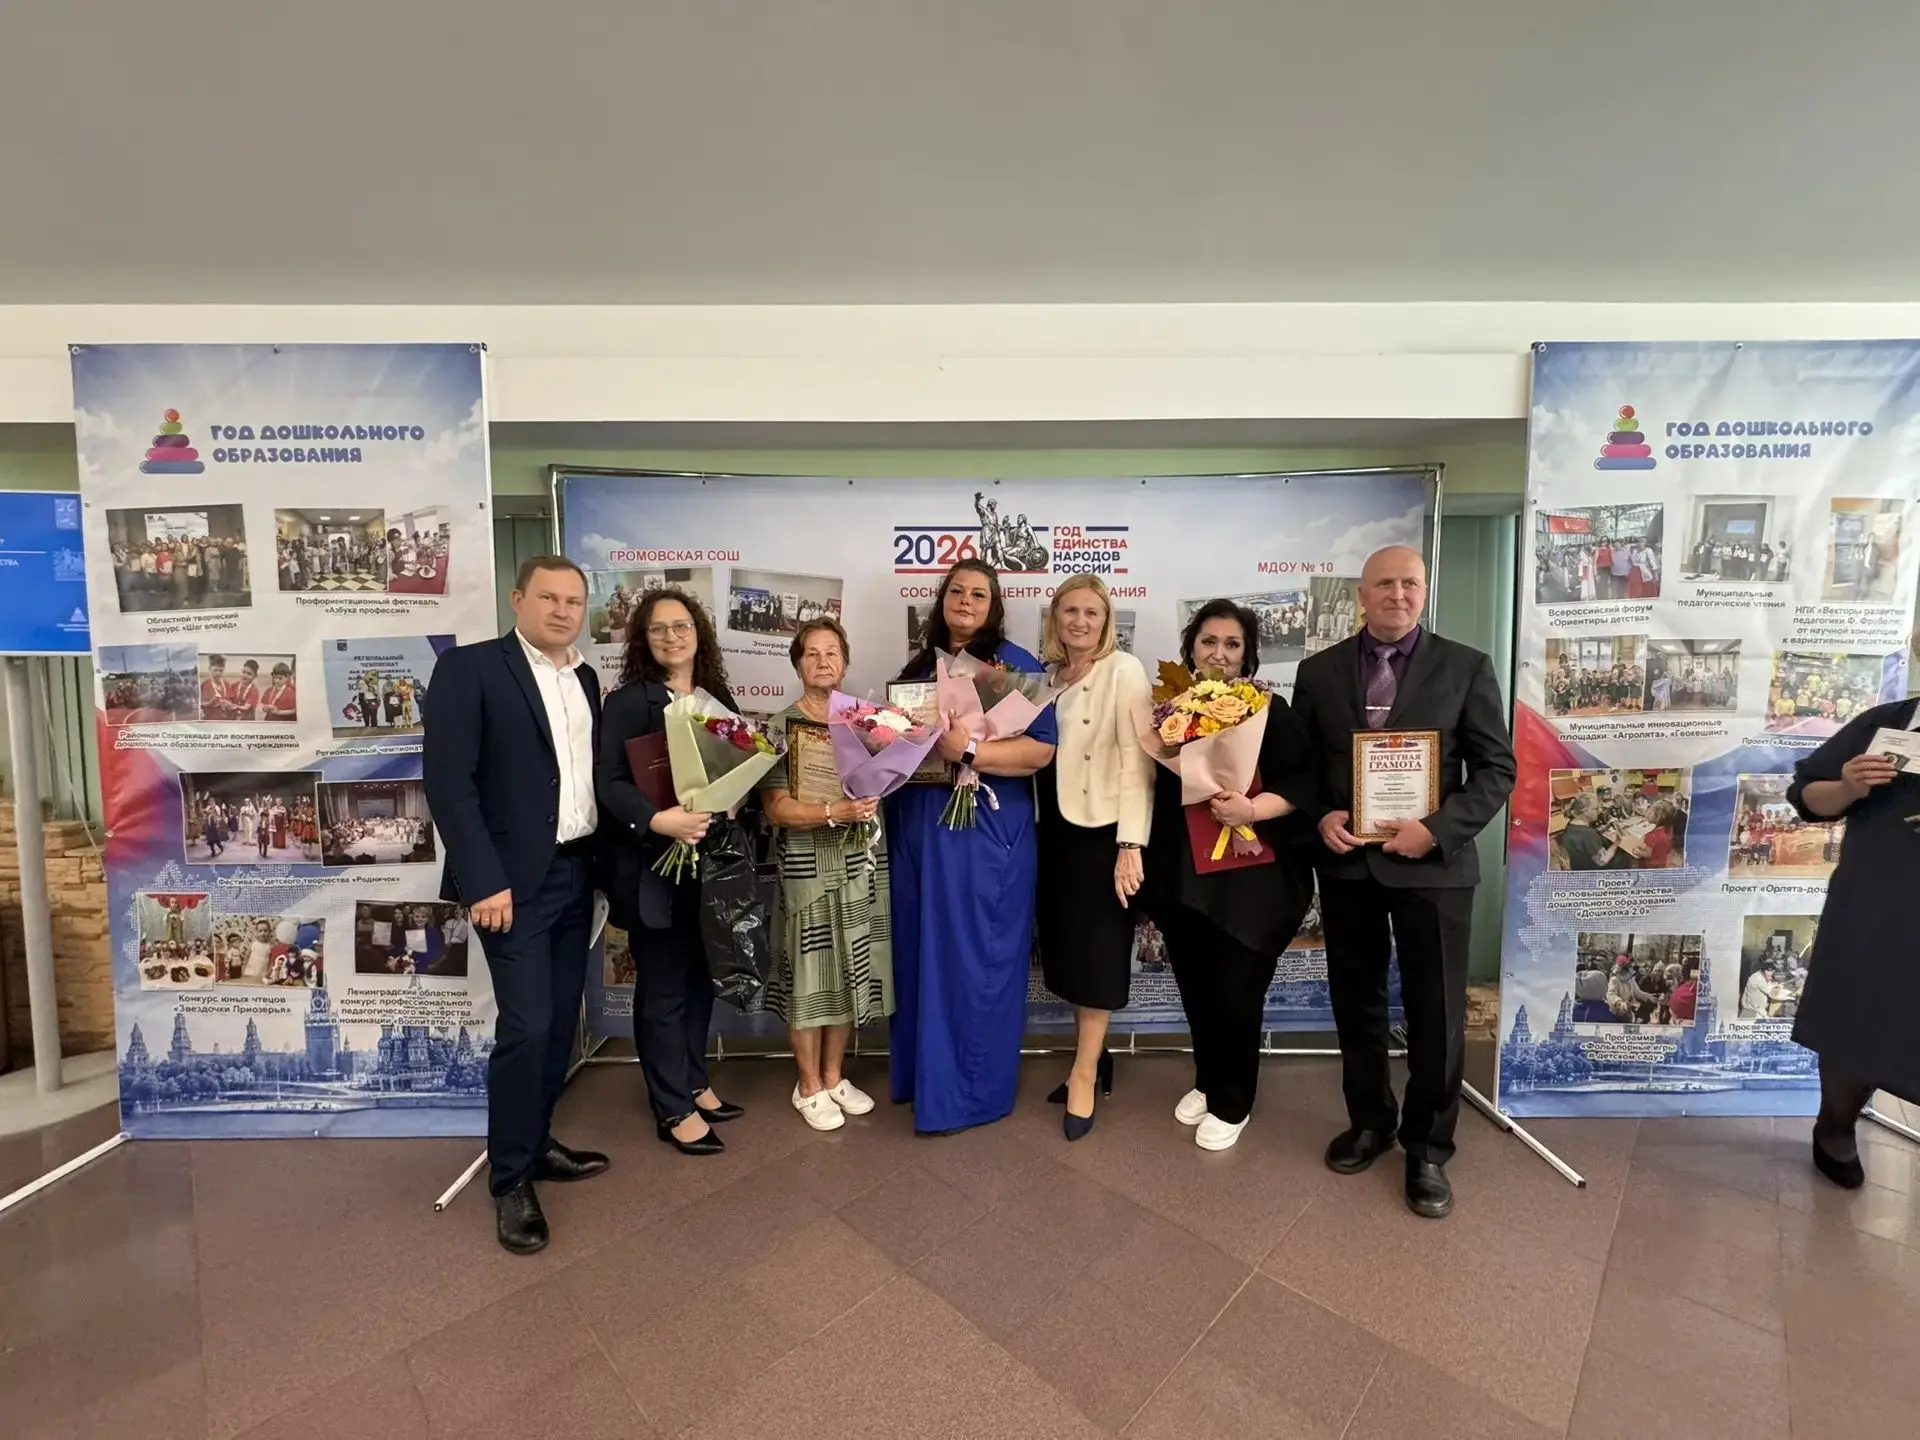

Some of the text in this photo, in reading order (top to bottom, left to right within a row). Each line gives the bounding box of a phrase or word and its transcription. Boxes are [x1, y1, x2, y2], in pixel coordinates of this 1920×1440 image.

[210, 425, 425, 440] ГОД ДОШКОЛЬНОГО
[1666, 421, 1874, 437] ГОД ДОШКОЛЬНОГО
[212, 447, 362, 463] ОБРАЗОВАНИЯ
[1665, 443, 1811, 459] ОБРАЗОВАНИЯ
[1053, 526, 1081, 538] ГОД
[893, 534, 977, 565] 2026
[1053, 539, 1128, 550] ЕДИНСТВА
[610, 550, 740, 561] ГРОМОВСКАЯ СОШ
[1053, 551, 1121, 563] НАРОДОВ
[1053, 564, 1112, 574] РОССИИ
[1257, 562, 1333, 574] МДОУ № 10
[900, 587, 938, 598] СОСН
[1696, 589, 1773, 598] Муниципальные
[296, 597, 439, 606] Профориентационный фестиваль
[1678, 599, 1751, 607] педагогические
[325, 606, 410, 615] «Азбука профессий»
[1548, 605, 1652, 617] Всероссийский форум
[1795, 606, 1815, 614] НПК
[1818, 607, 1862, 615] «Векторы
[146, 612, 239, 625] Областной творческий
[1550, 615, 1650, 627] «Ориентиры детства»
[1793, 617, 1845, 625] педагогики
[148, 621, 237, 634] конкурс «Шаг вперёд»
[1810, 627, 1848, 635] научной
[1790, 637, 1854, 645] вариативным
[750, 685, 784, 696] ООШ
[1569, 720, 1722, 732] Муниципальные инновационные
[120, 731, 160, 740] Районная
[161, 732, 212, 741] Спартакиада
[1560, 732, 1610, 741] площадки:
[1670, 729, 1728, 738] «Геокешинг»
[116, 741, 300, 750] дошкольных образовательных учреждений
[1742, 737, 1770, 745] Проект
[1773, 739, 1817, 747] «Академия
[315, 747, 377, 757] Региональный
[1369, 761, 1422, 769] ГРАМОТА
[218, 876, 400, 886] Фестиваль детского творчества «Родничок»
[1598, 879, 1631, 887] Проект
[1721, 883, 1757, 893] Проект
[1570, 890, 1628, 898] повышению
[1547, 897, 1676, 909] дошкольного образования
[1577, 909, 1629, 918] «Дошколка
[347, 988, 468, 997] Ленинградский областной
[178, 994, 286, 1004] Конкурс юных чтецов
[380, 998, 473, 1007] профессионального
[233, 1005, 291, 1014] Приозерья»
[342, 1008, 471, 1017] педагогического мастерства
[393, 1018, 456, 1026] «Воспитатель
[1605, 1033, 1655, 1042] Программа
[1581, 1043, 1651, 1051] «Фольклорные
